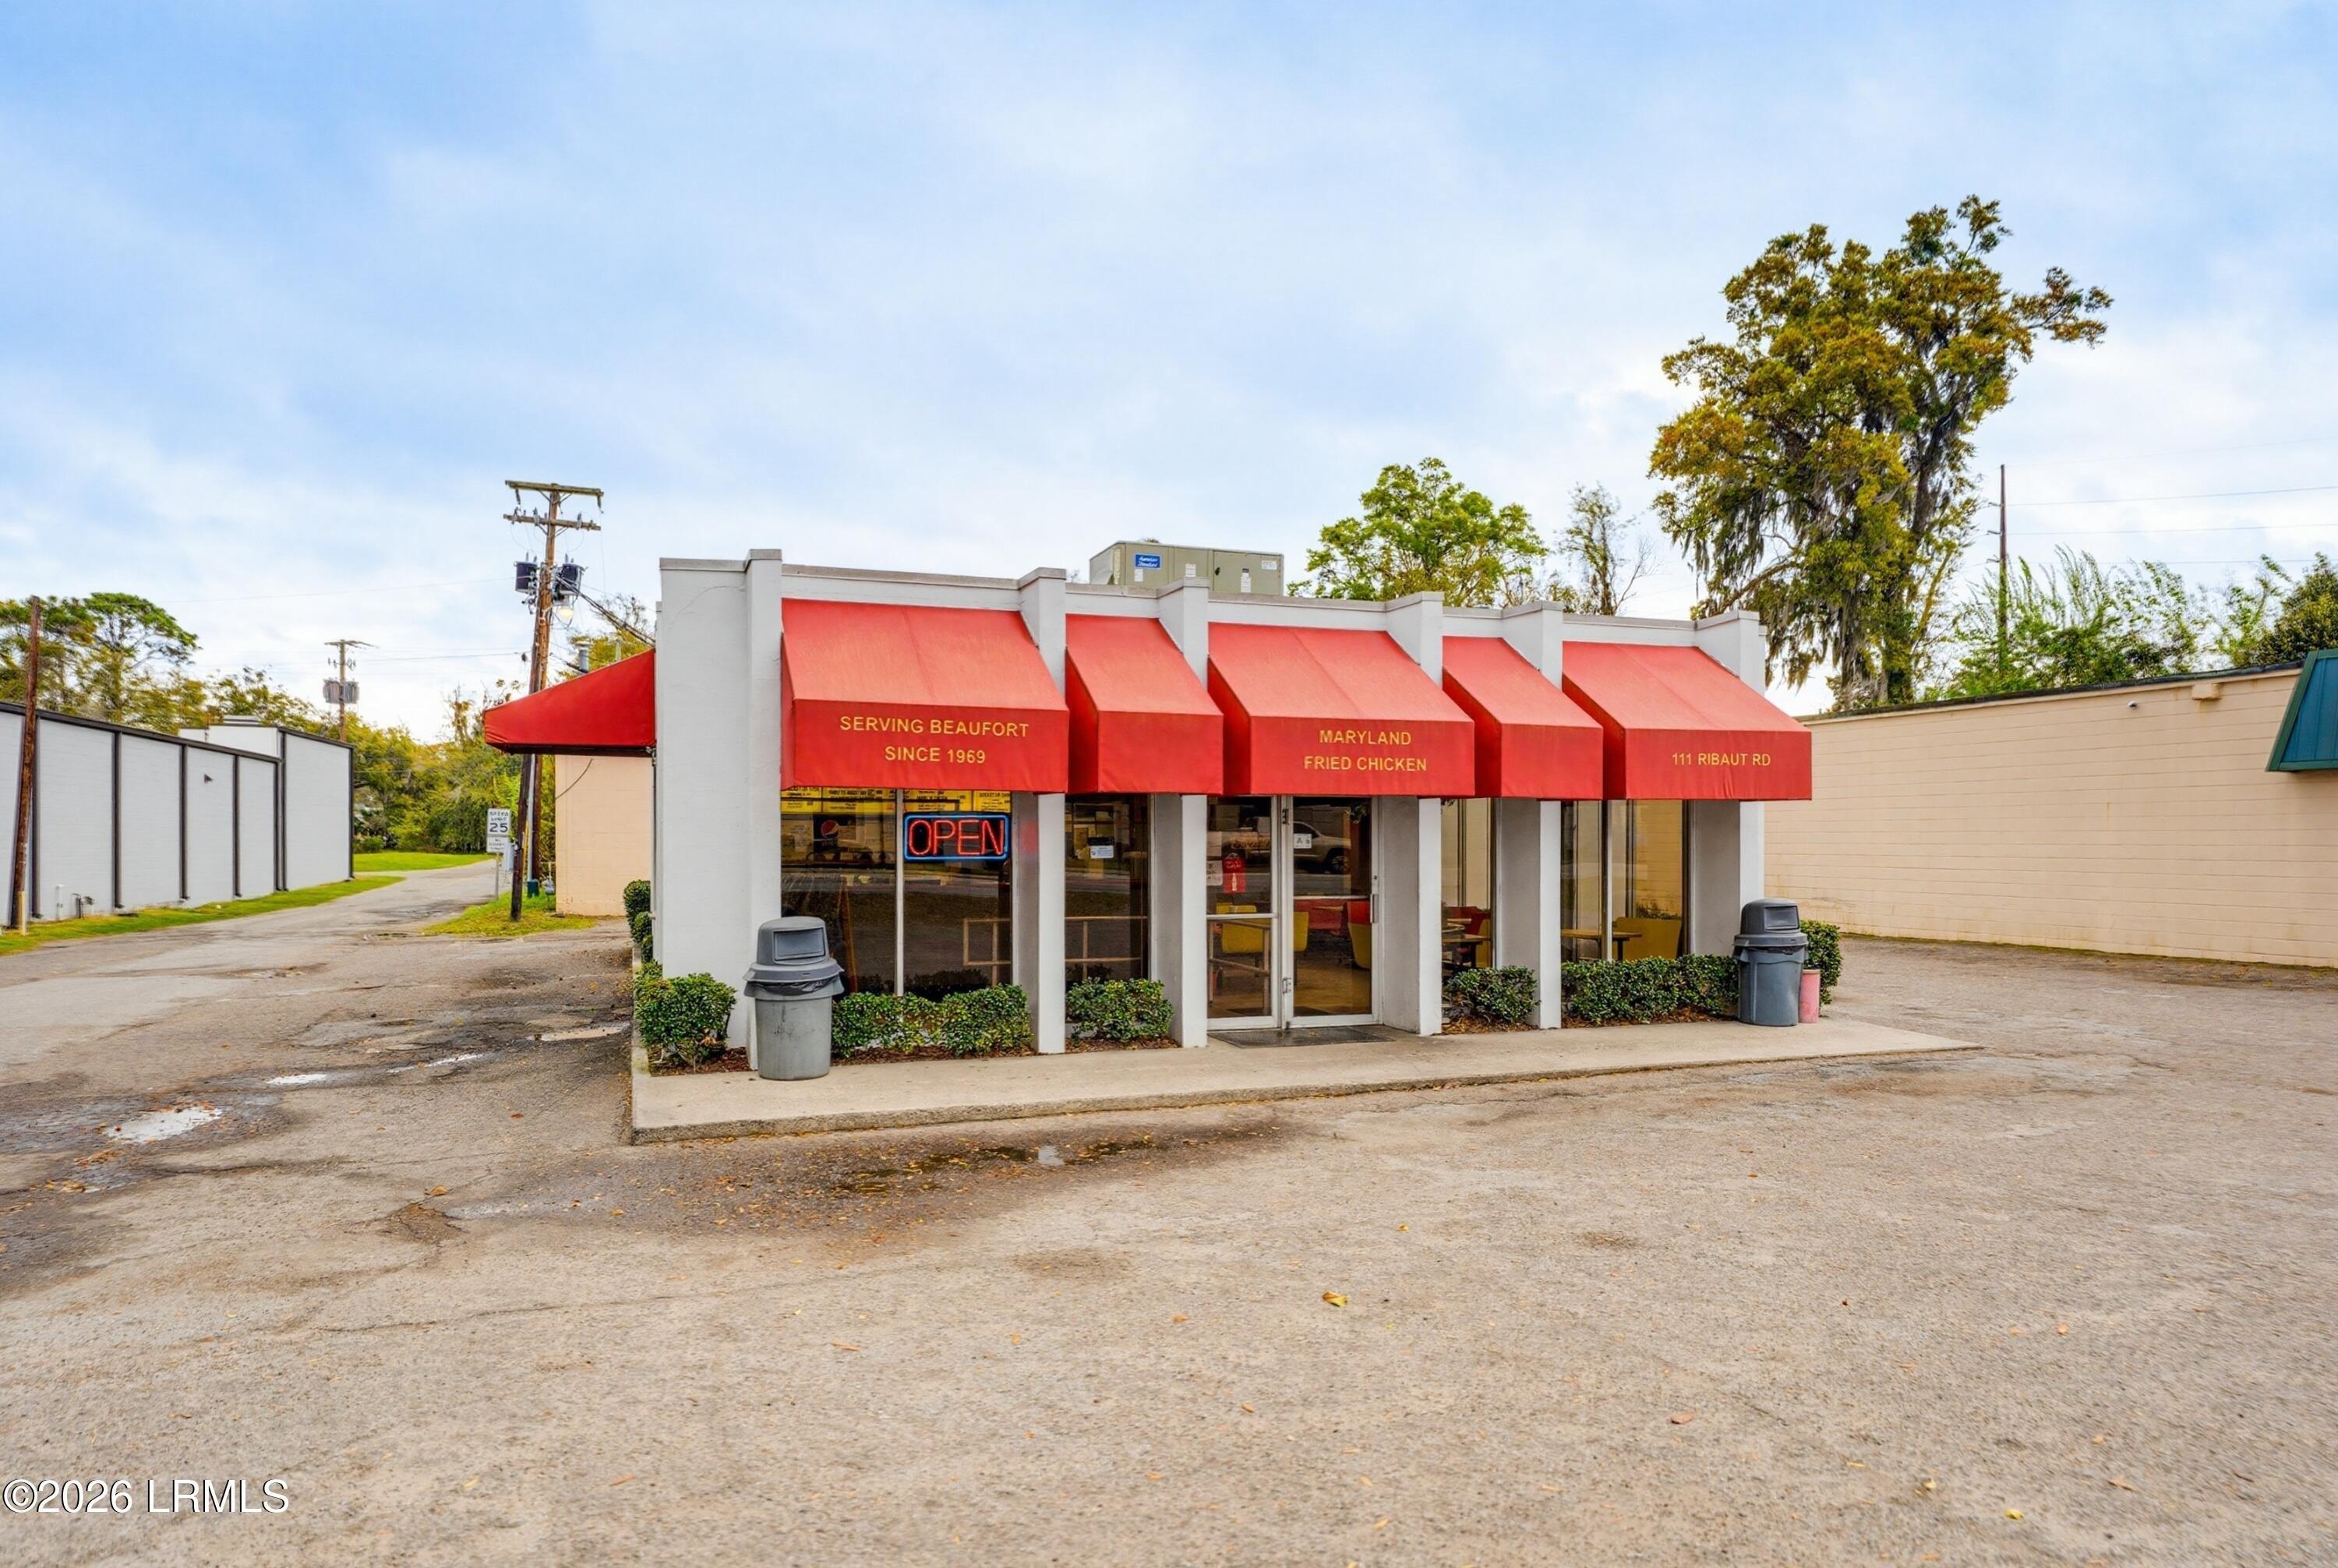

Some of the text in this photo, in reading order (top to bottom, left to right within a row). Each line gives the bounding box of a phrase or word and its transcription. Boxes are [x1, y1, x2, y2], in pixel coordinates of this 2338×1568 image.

[839, 715, 1029, 737] SERVING BEAUFORT
[1319, 729, 1411, 746] MARYLAND
[885, 746, 986, 765] SINCE 1969
[1303, 755, 1427, 772] FRIED CHICKEN
[1672, 752, 1771, 766] 111 RIBAUT RD
[489, 822, 508, 833] 25
[908, 819, 1005, 856] OPEN
